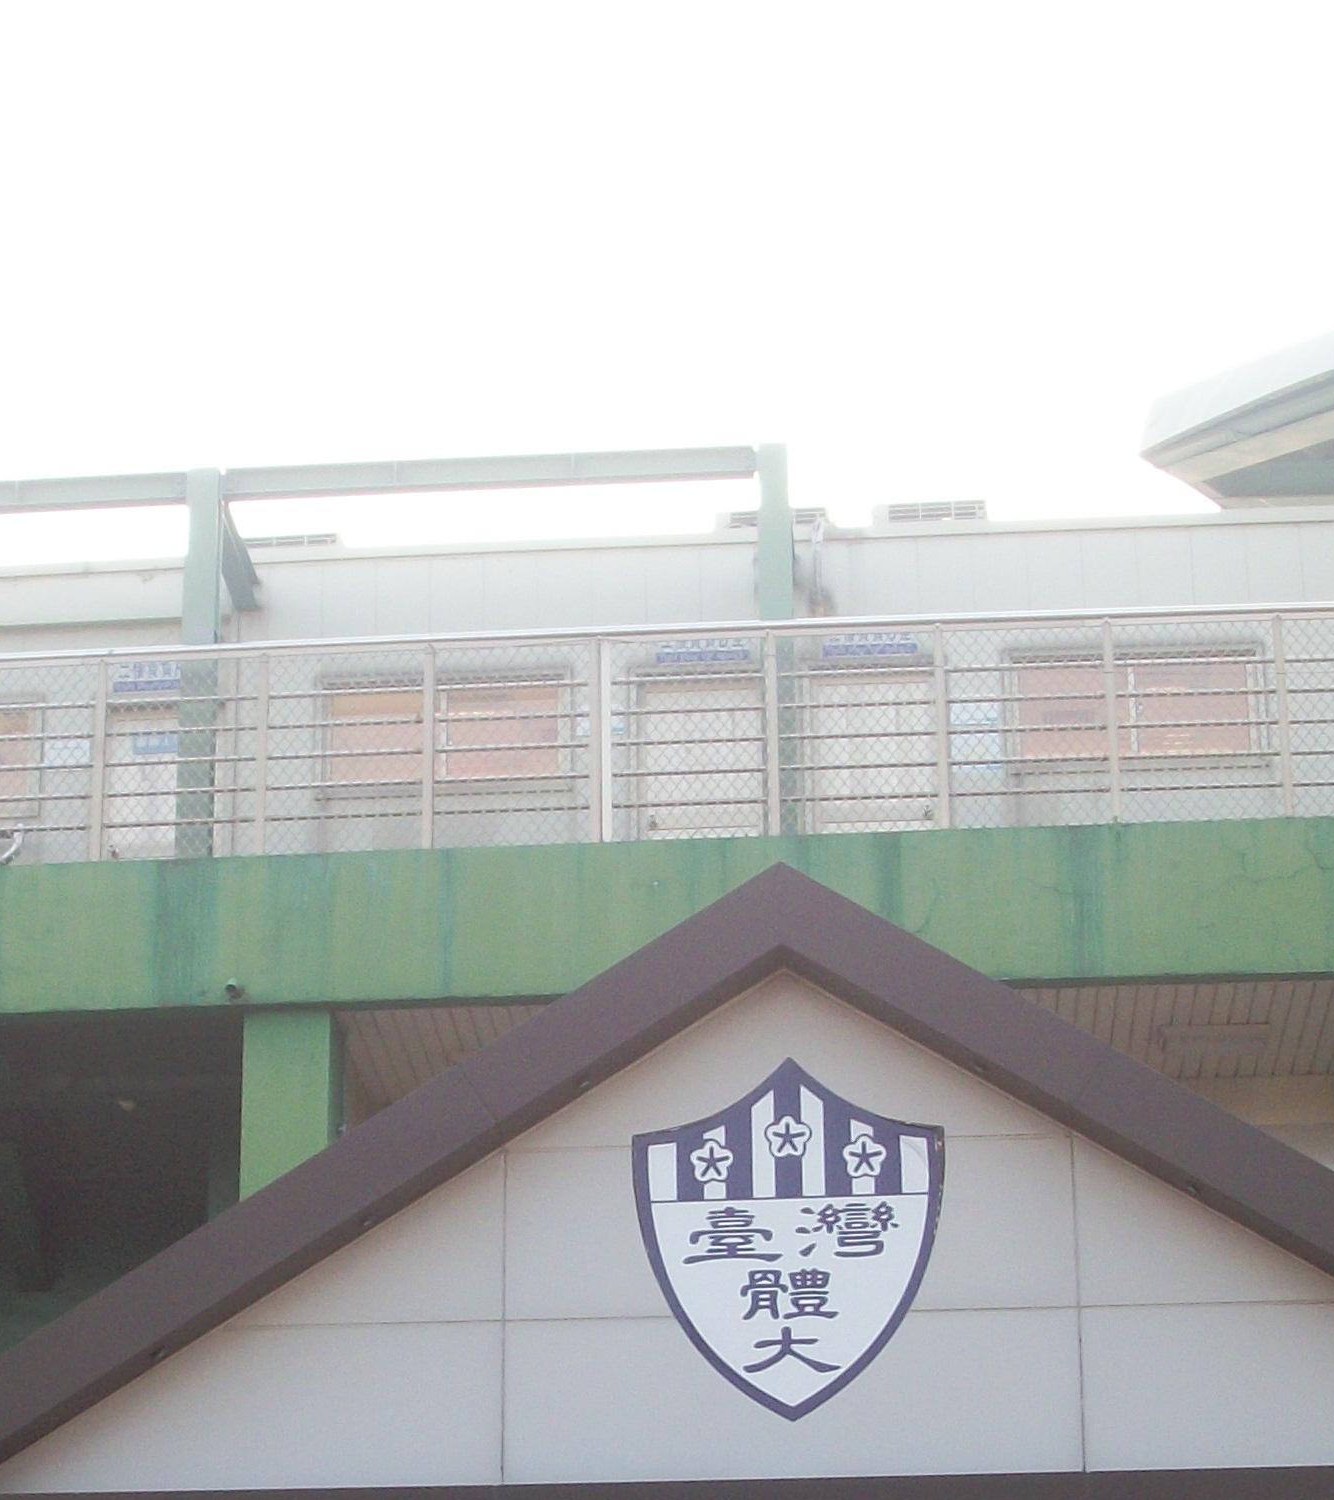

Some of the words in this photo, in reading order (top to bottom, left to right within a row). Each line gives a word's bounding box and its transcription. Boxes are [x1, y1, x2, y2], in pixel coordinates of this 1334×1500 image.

[682, 1200, 900, 1264] 臺灣
[740, 1268, 839, 1320] 體
[743, 1326, 841, 1374] 大
